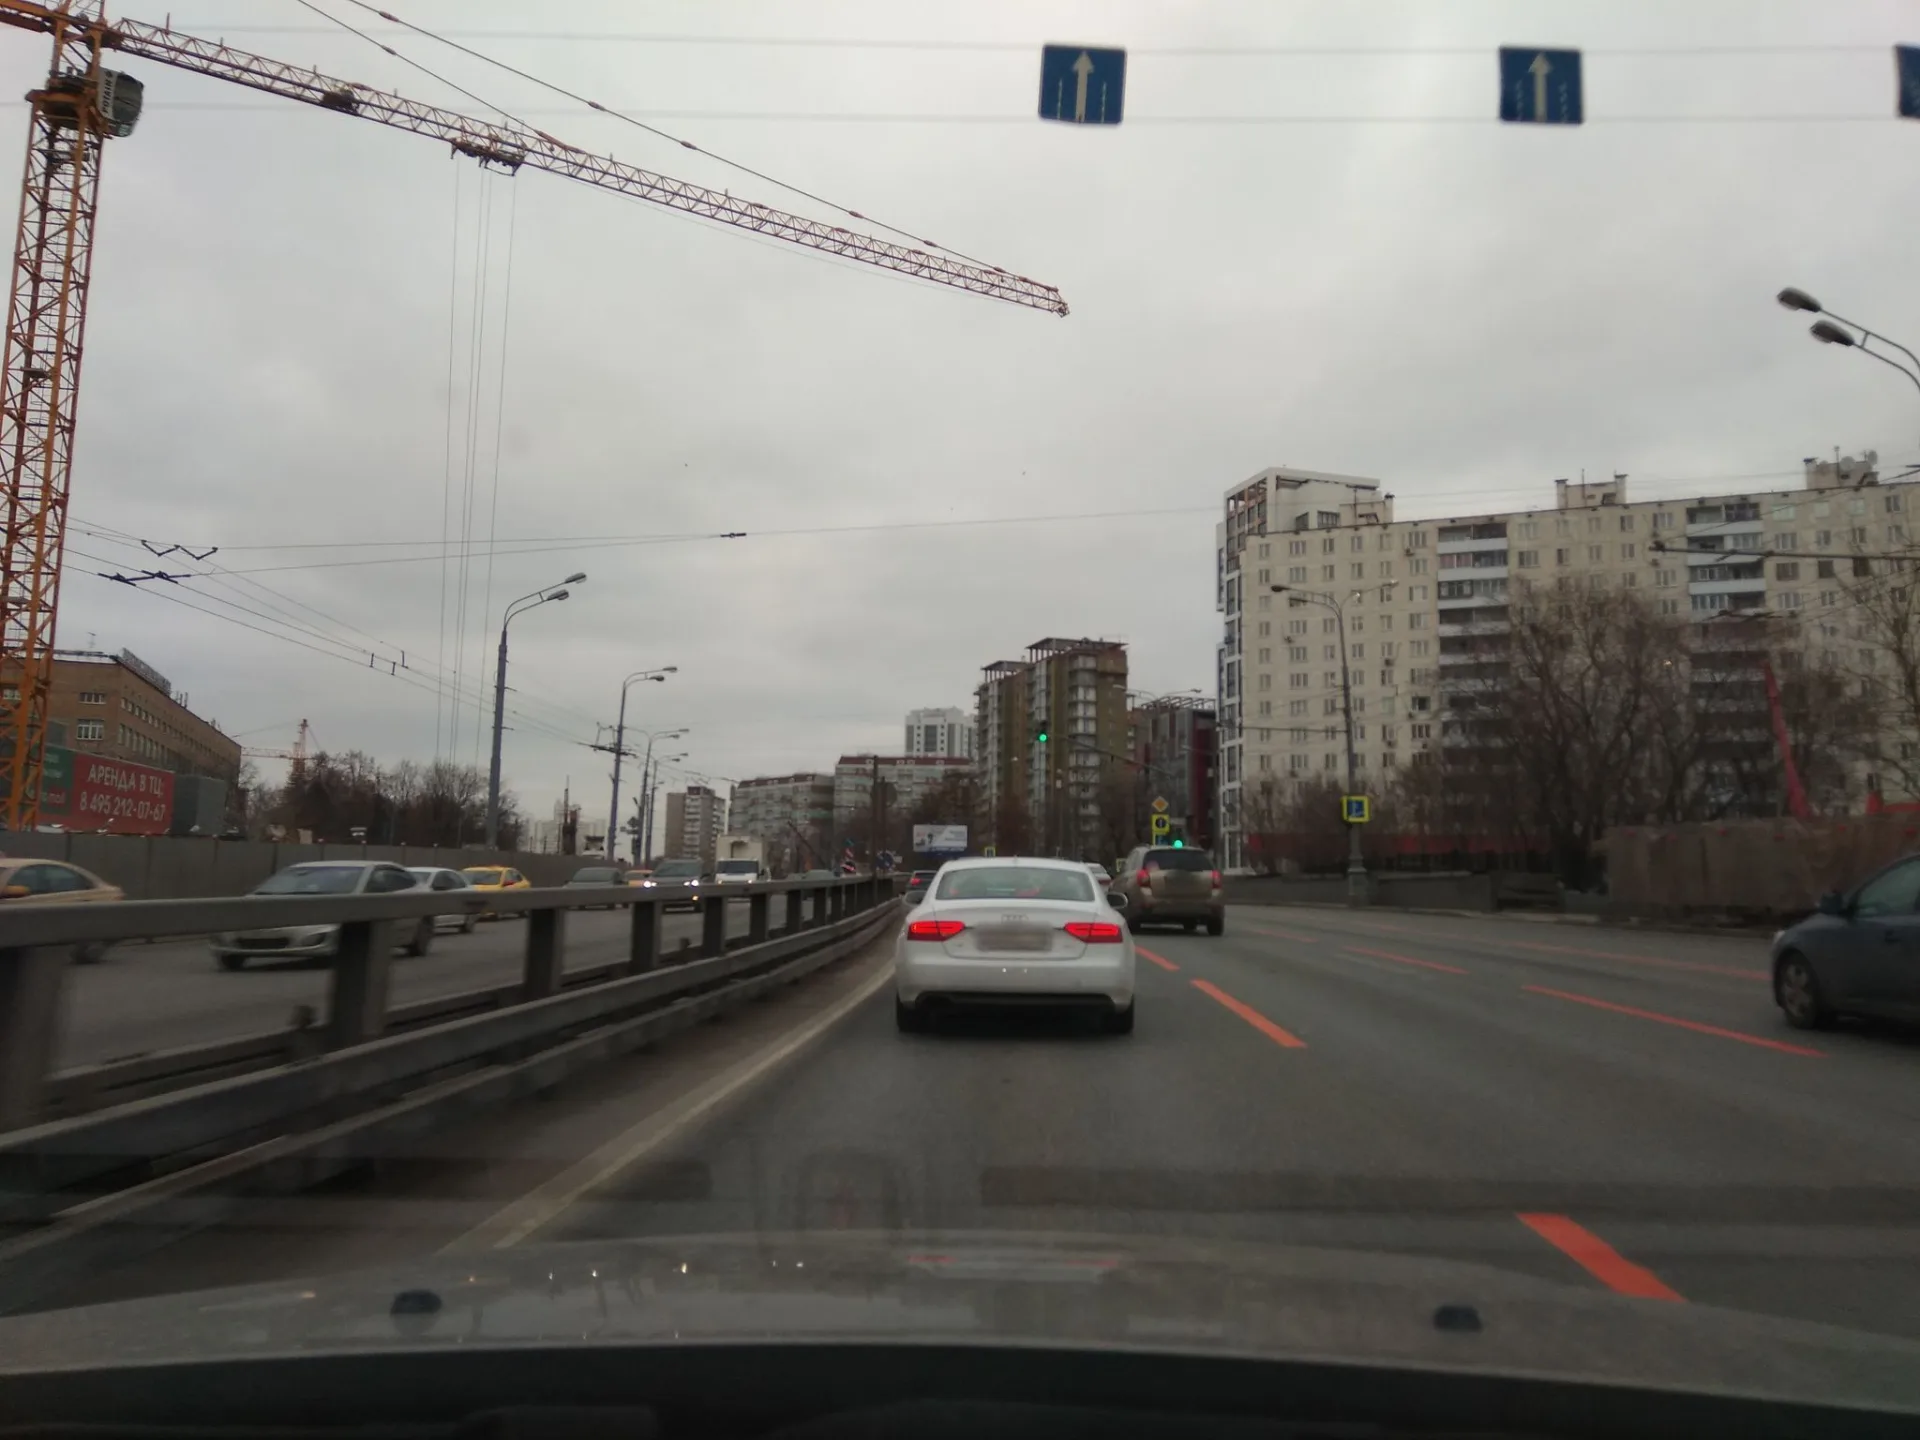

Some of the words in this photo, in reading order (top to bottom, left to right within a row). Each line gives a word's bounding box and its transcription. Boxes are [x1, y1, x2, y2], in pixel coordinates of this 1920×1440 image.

[102, 79, 113, 114] POTAIN
[87, 764, 136, 792] АРЕНДА
[139, 773, 147, 792] В
[80, 791, 88, 812] 8
[90, 793, 111, 815] 495
[112, 796, 166, 821] 212-07-67
